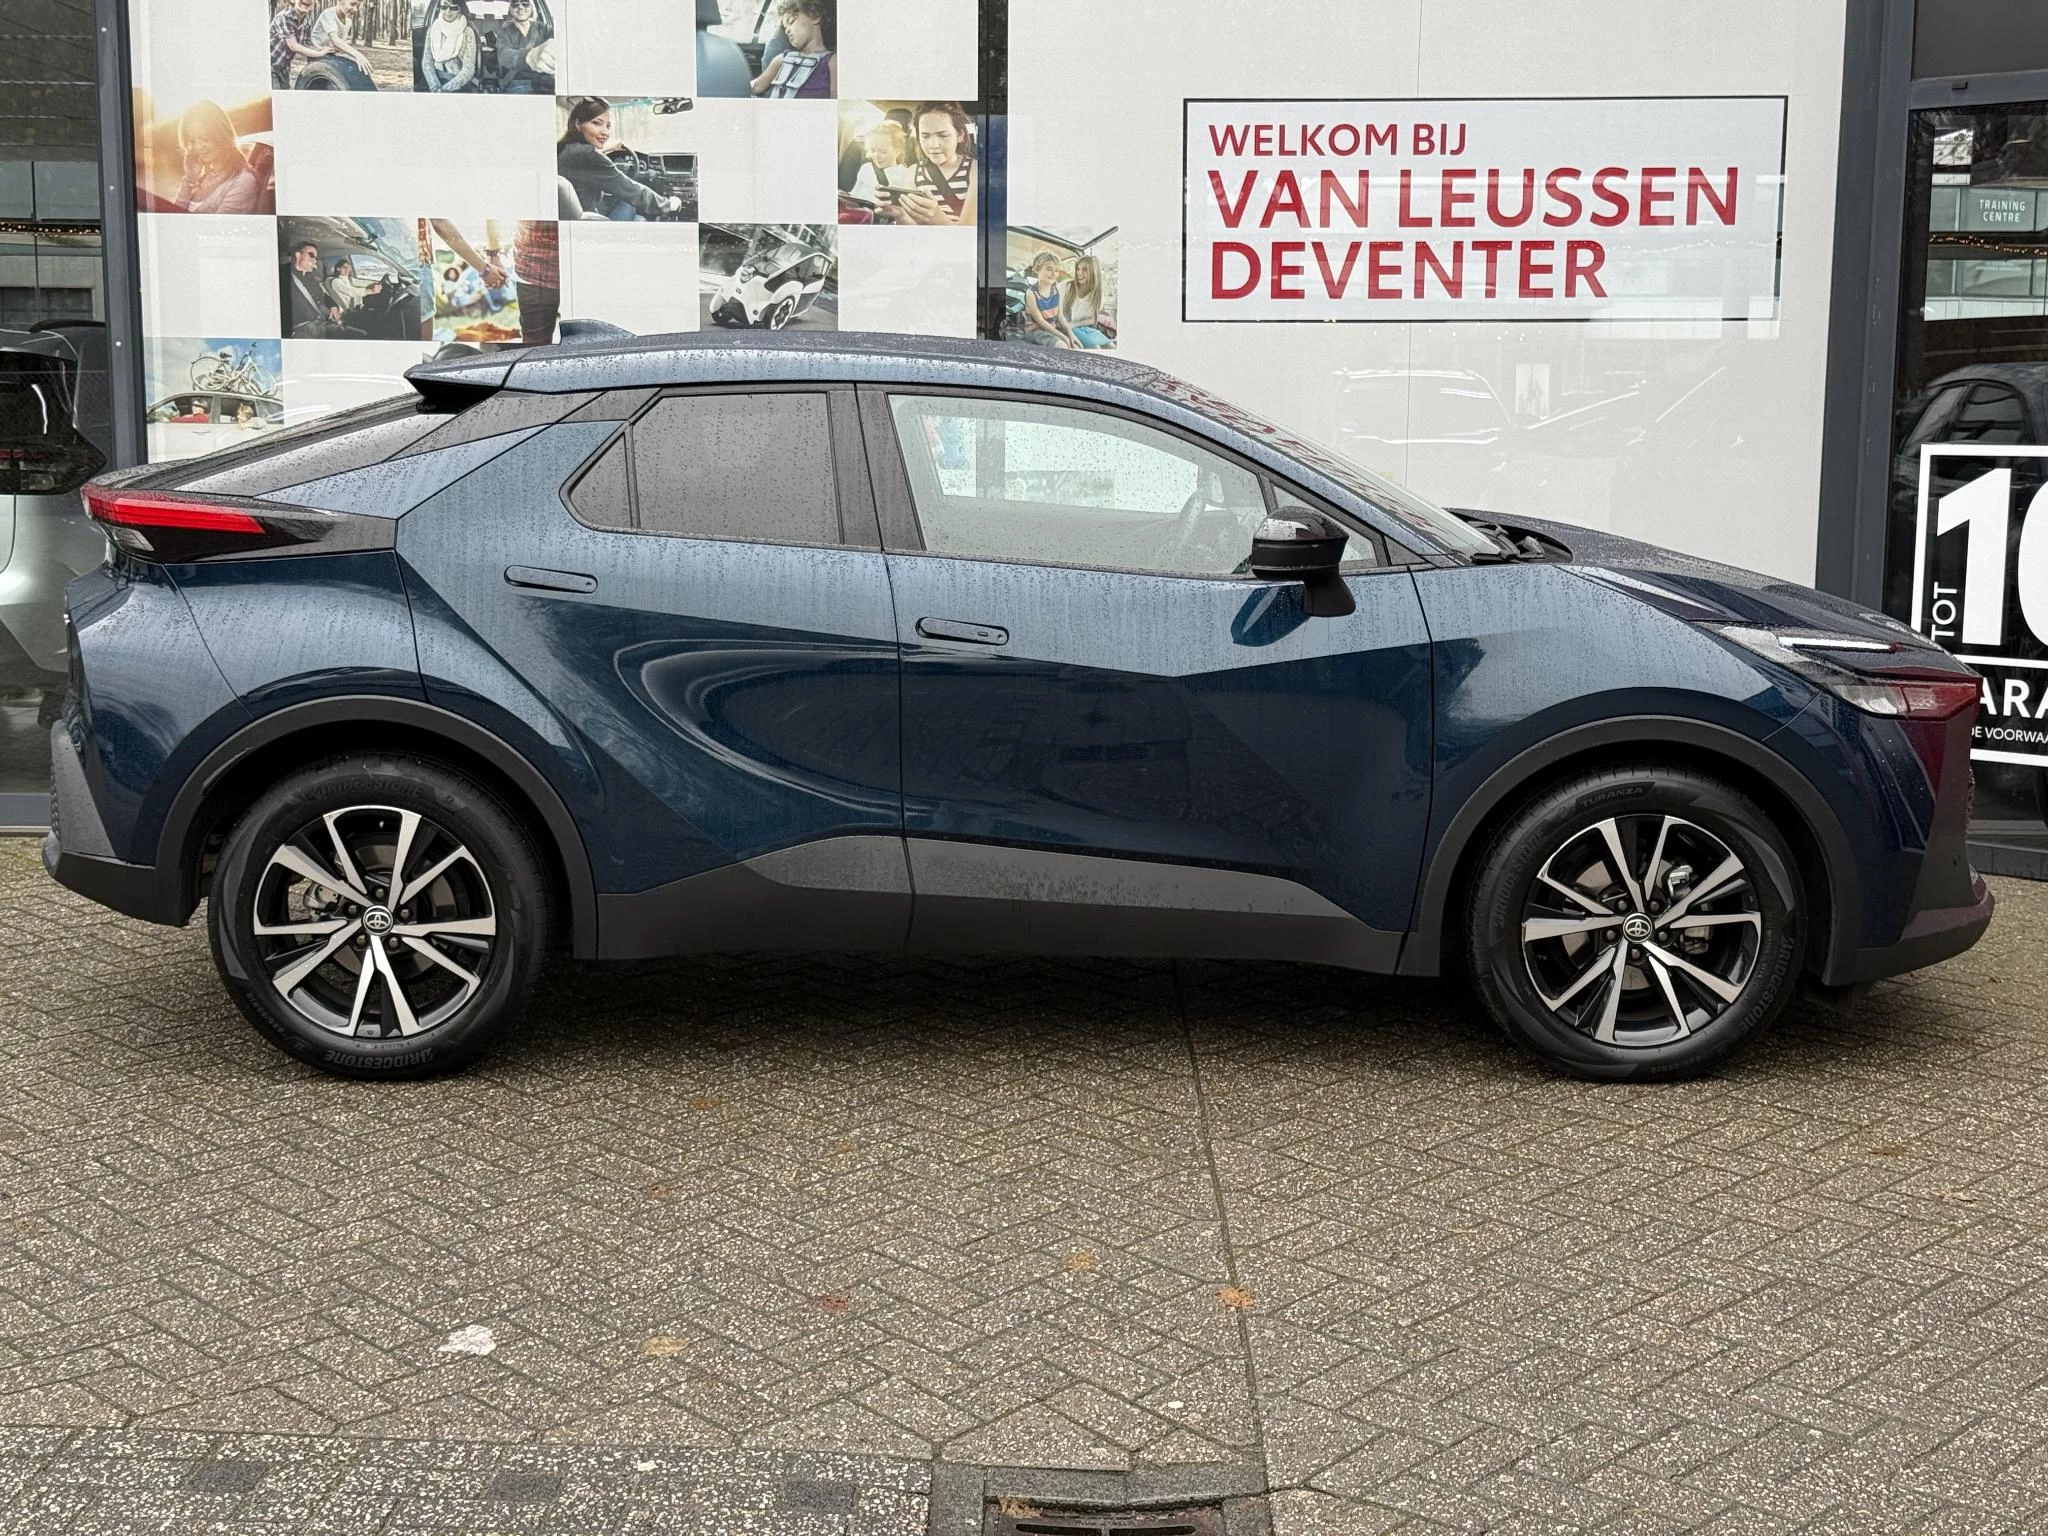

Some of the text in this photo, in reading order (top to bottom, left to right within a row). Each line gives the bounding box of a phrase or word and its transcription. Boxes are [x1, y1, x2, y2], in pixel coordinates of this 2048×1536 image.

[1209, 123, 1467, 157] WELKOM BIJ
[1208, 166, 1739, 229] VAN LEUSSEN
[1979, 199, 2026, 212] TRAINING
[1983, 211, 2021, 223] CENTRE
[1211, 239, 1608, 300] DEVENTER
[1930, 581, 1958, 642] TOT
[1979, 676, 2048, 719] AR
[1581, 785, 1645, 808] TURANZA
[1740, 934, 1796, 1034] BRIDGESTONE
[323, 1046, 434, 1070] BRIDGESTONE
